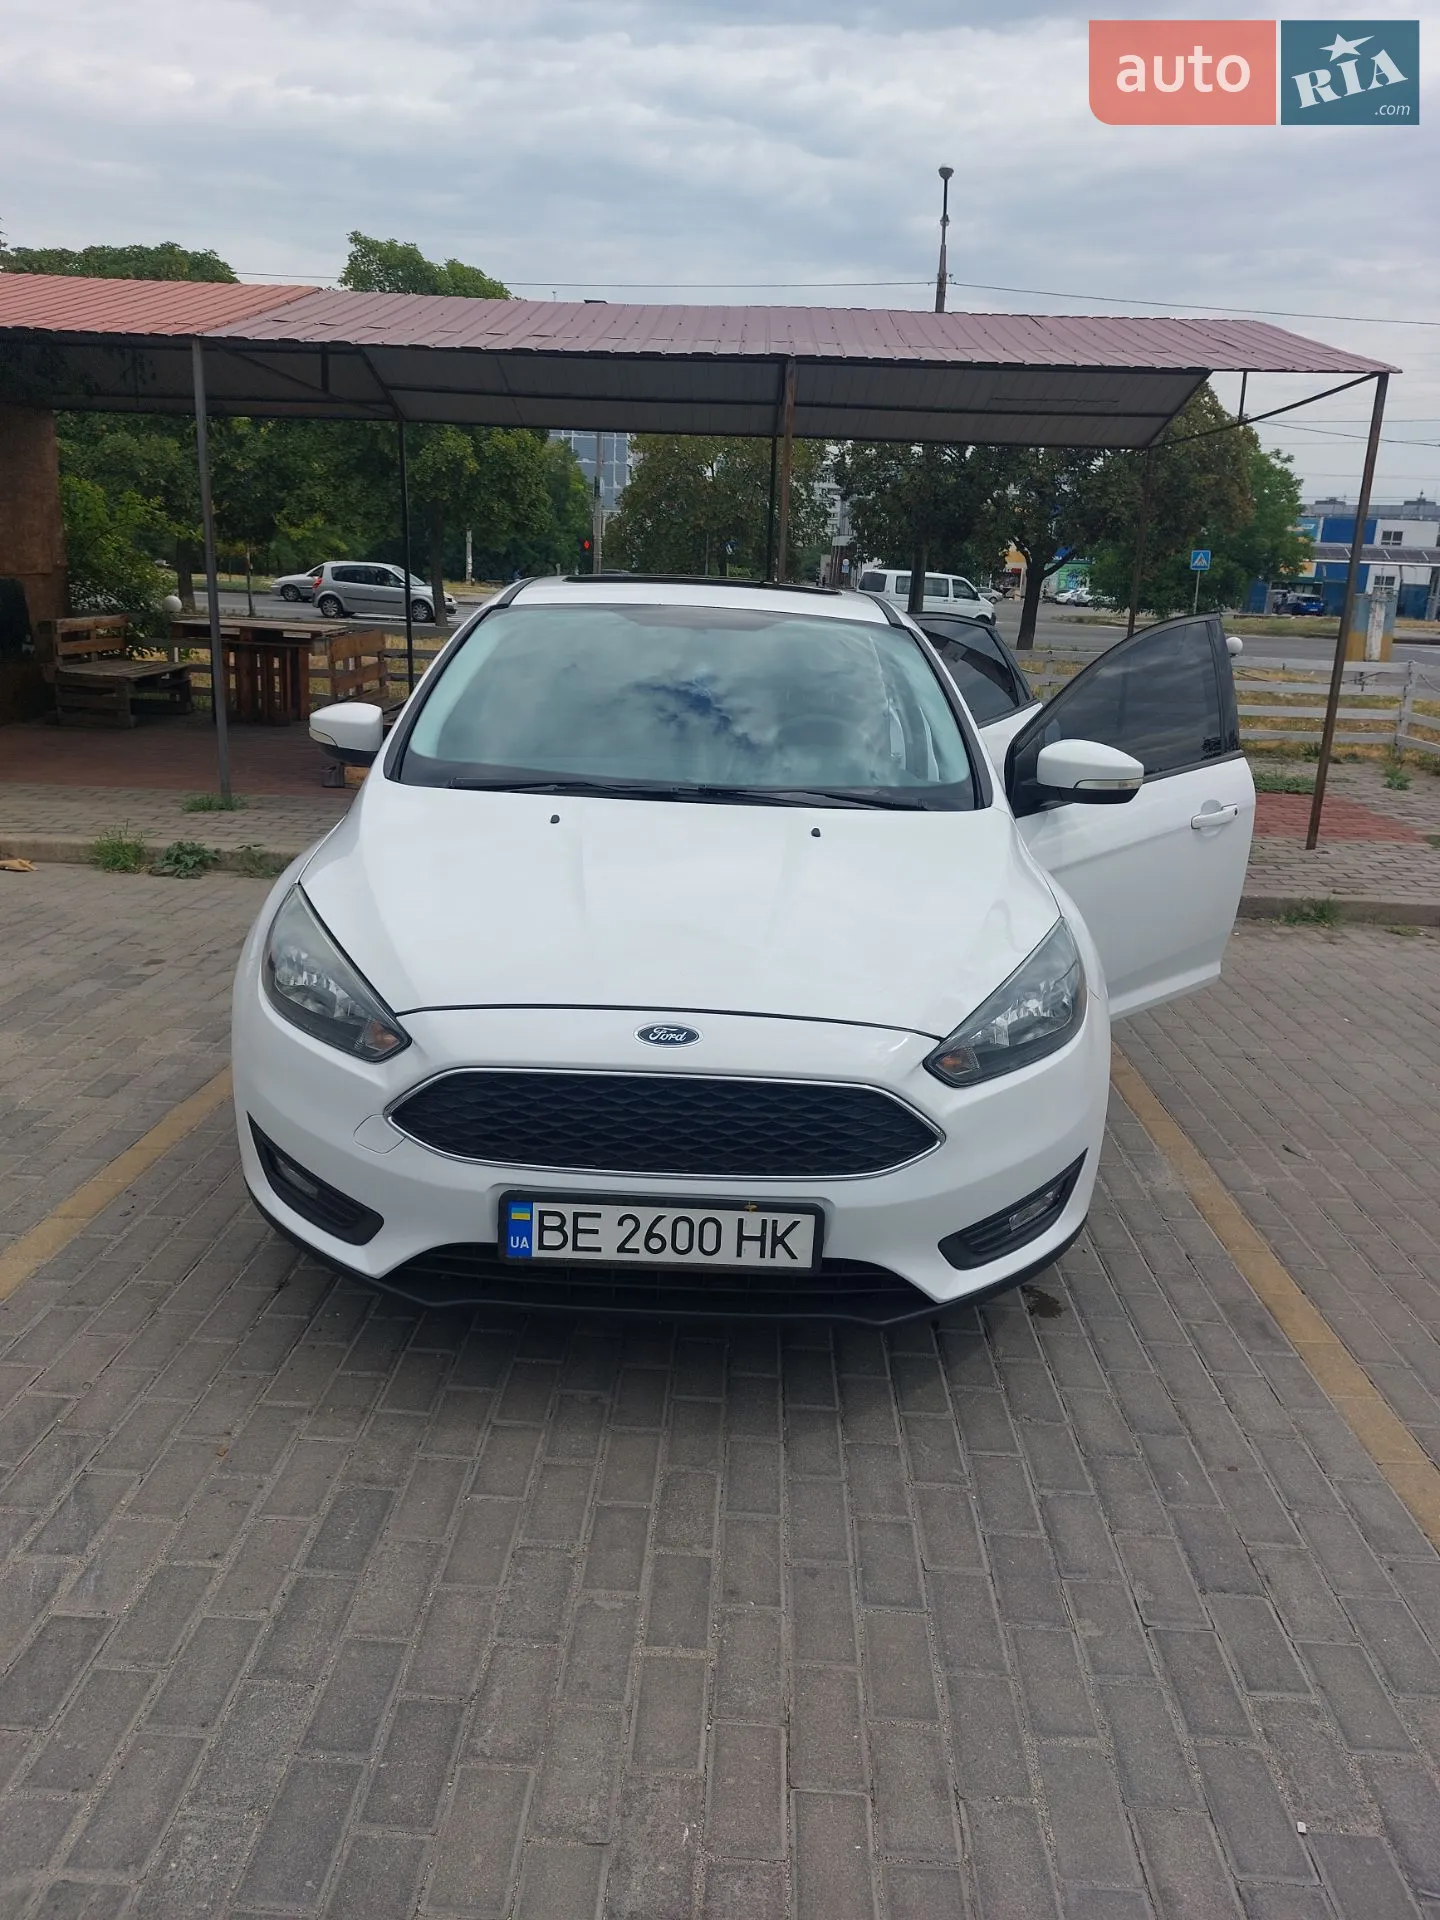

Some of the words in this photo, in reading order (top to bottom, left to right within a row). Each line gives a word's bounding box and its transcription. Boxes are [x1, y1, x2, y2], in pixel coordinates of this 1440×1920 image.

[648, 1026, 688, 1042] Ford
[510, 1235, 530, 1249] UA
[537, 1209, 603, 1253] BE
[616, 1214, 723, 1257] 2600
[735, 1216, 802, 1260] HK
